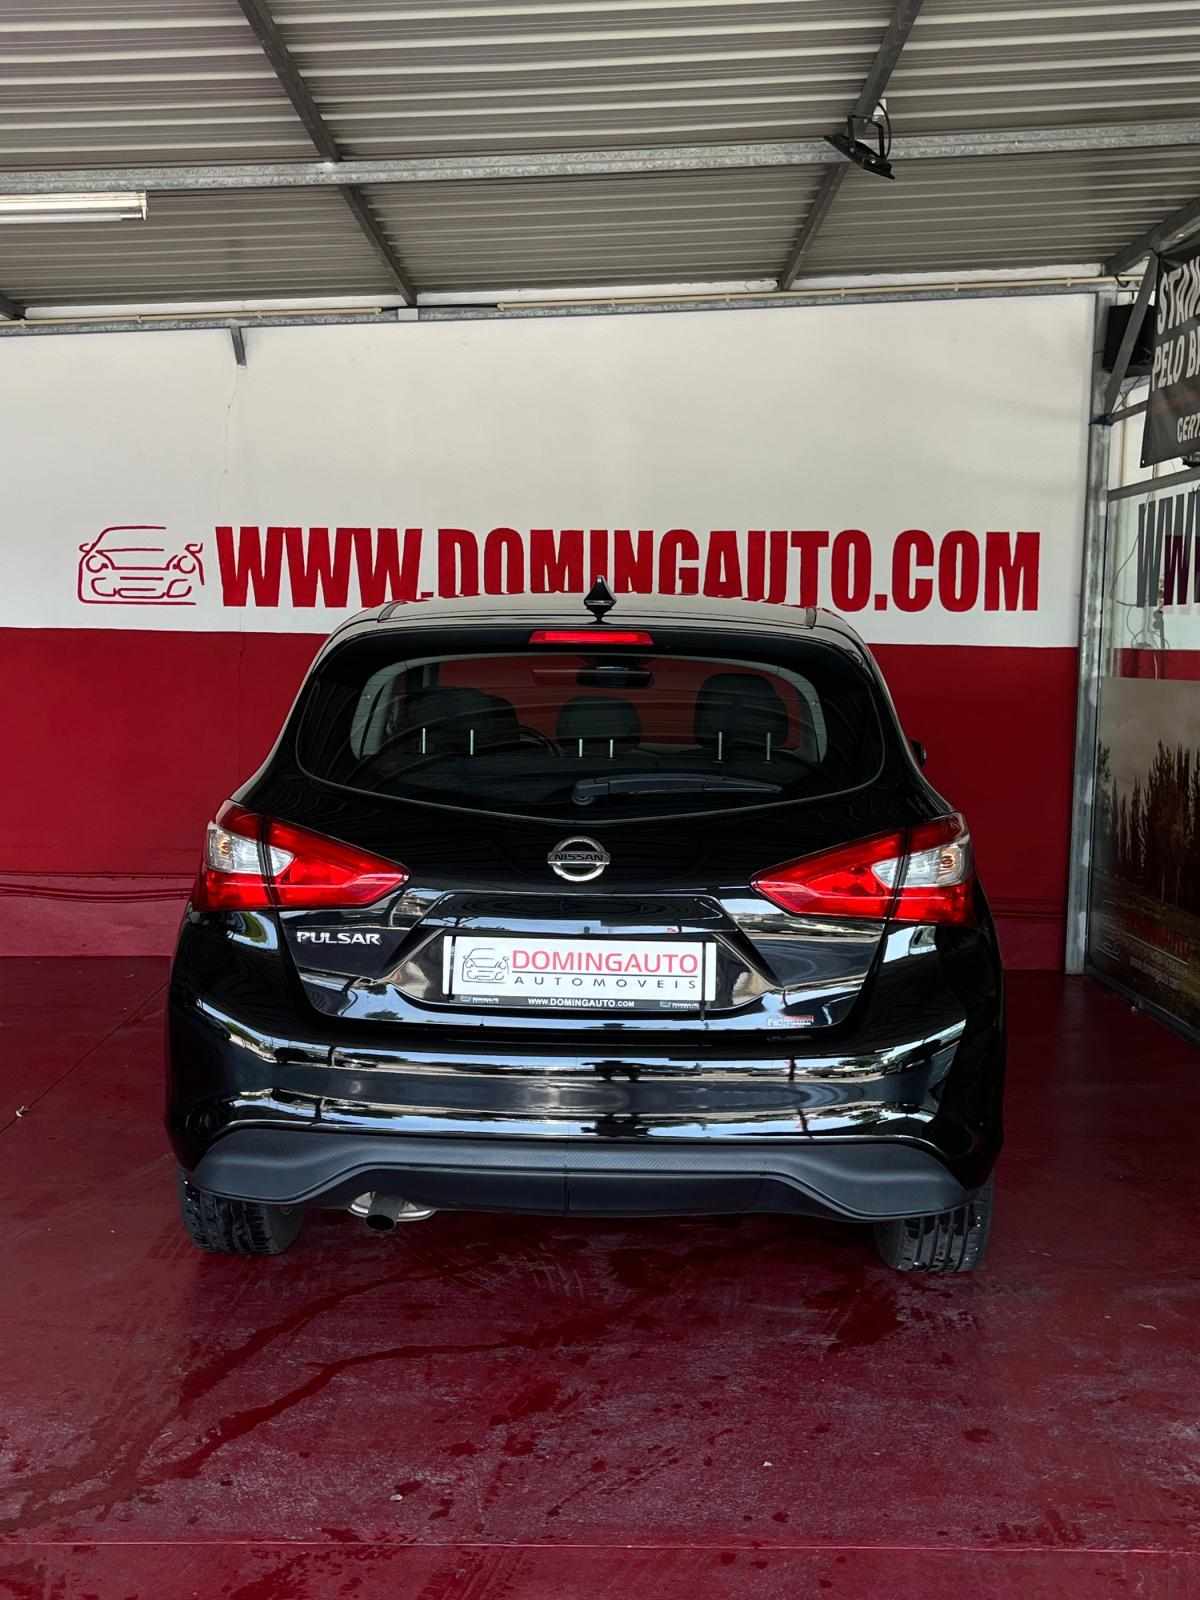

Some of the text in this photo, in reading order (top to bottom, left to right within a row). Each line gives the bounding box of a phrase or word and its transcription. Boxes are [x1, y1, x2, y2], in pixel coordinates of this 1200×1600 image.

[1157, 256, 1200, 335] STAN
[1152, 335, 1185, 392] PELO
[1177, 412, 1200, 443] CERT
[554, 853, 604, 862] NISSAN
[296, 931, 381, 945] PULSAR
[512, 950, 698, 973] DOMINGAUTO
[514, 976, 696, 989] AUTOMOVEIS
